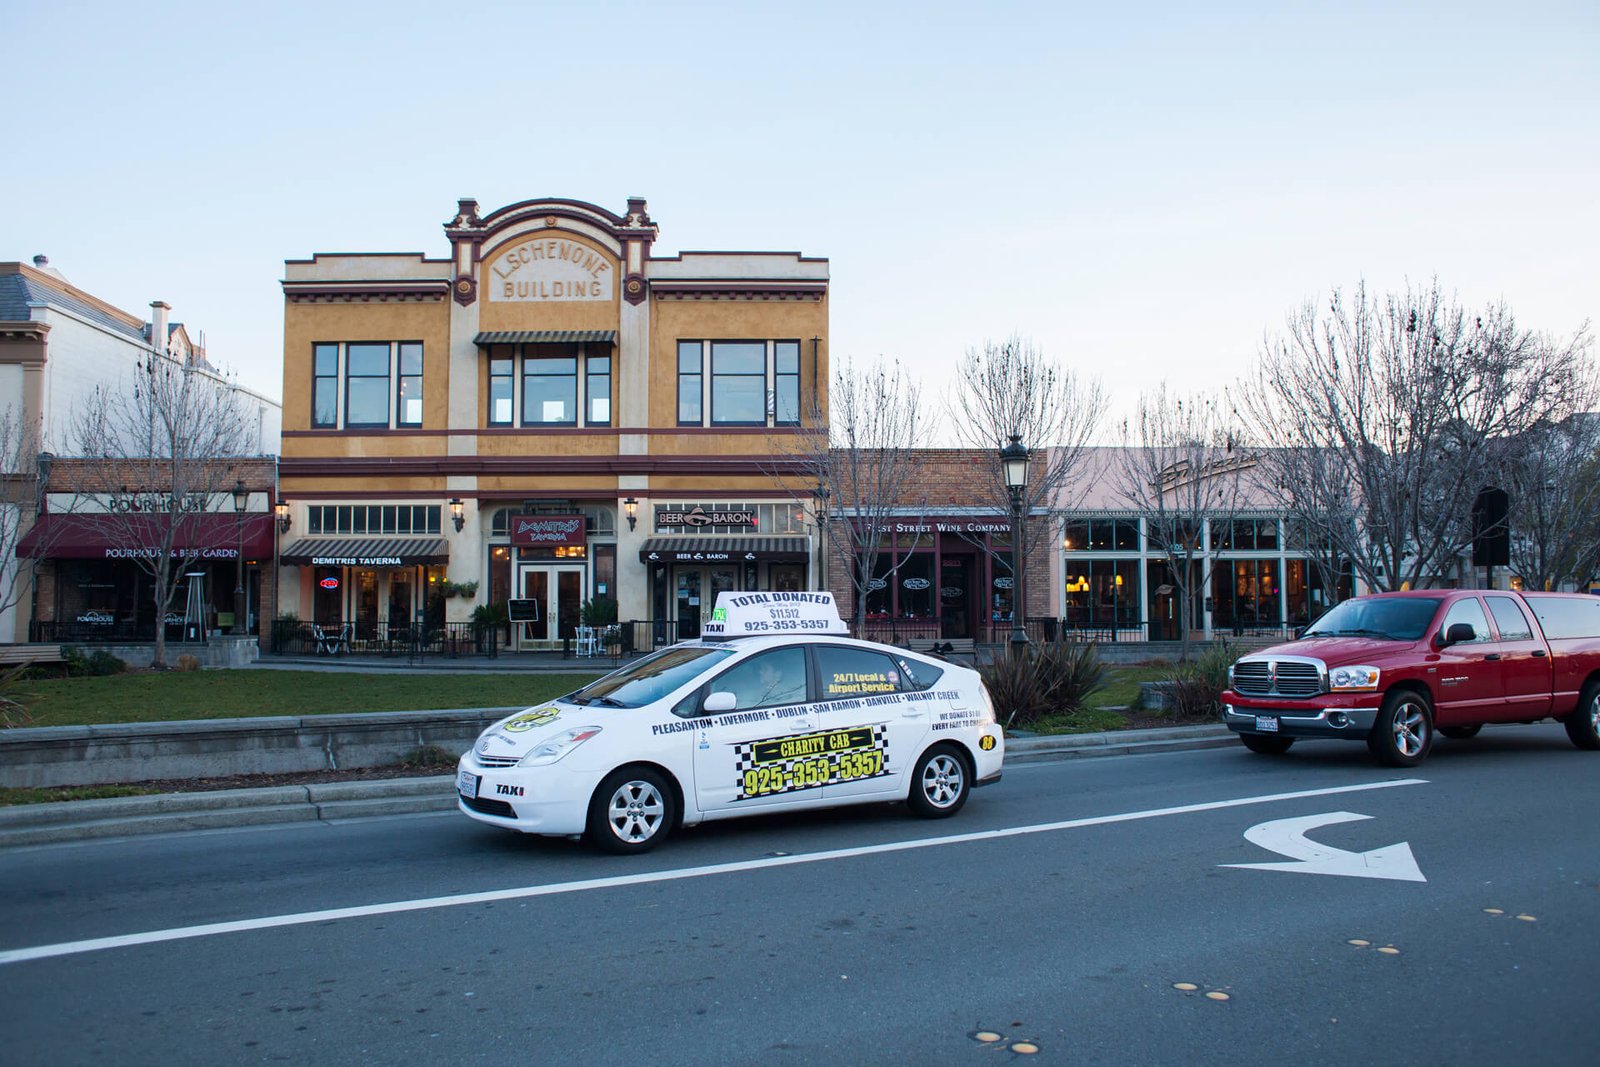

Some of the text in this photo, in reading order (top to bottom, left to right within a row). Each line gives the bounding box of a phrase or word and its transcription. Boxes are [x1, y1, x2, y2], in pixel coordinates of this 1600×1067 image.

[503, 281, 602, 298] BUILDING
[660, 513, 751, 523] BEER BARON
[896, 523, 932, 532] STREET
[936, 523, 961, 532] WINE
[967, 523, 1011, 532] COMPANY
[105, 549, 164, 558] POURHOUS
[170, 549, 177, 558] &
[312, 557, 402, 565] DEMITRIS TAVERNA
[320, 579, 339, 588] OPEN
[730, 592, 831, 608] TOTAL DONATED
[769, 608, 800, 619] $11,512
[704, 624, 725, 633] TAXI
[744, 619, 829, 632] 925-353-5357
[833, 673, 853, 683] 24/7
[854, 672, 878, 682] Local
[828, 682, 895, 693] Airport Service
[651, 690, 960, 736] PLEASANTON LIVERMORE DUBLIN SAN RAMON DANVILLE WALNUT CREEK
[940, 713, 948, 721] WE
[932, 723, 949, 731] EVERY
[780, 733, 850, 758] CHARITY CAB
[982, 736, 993, 750] 88
[744, 750, 883, 796] 925-353-5357
[496, 783, 525, 797] TAXI
